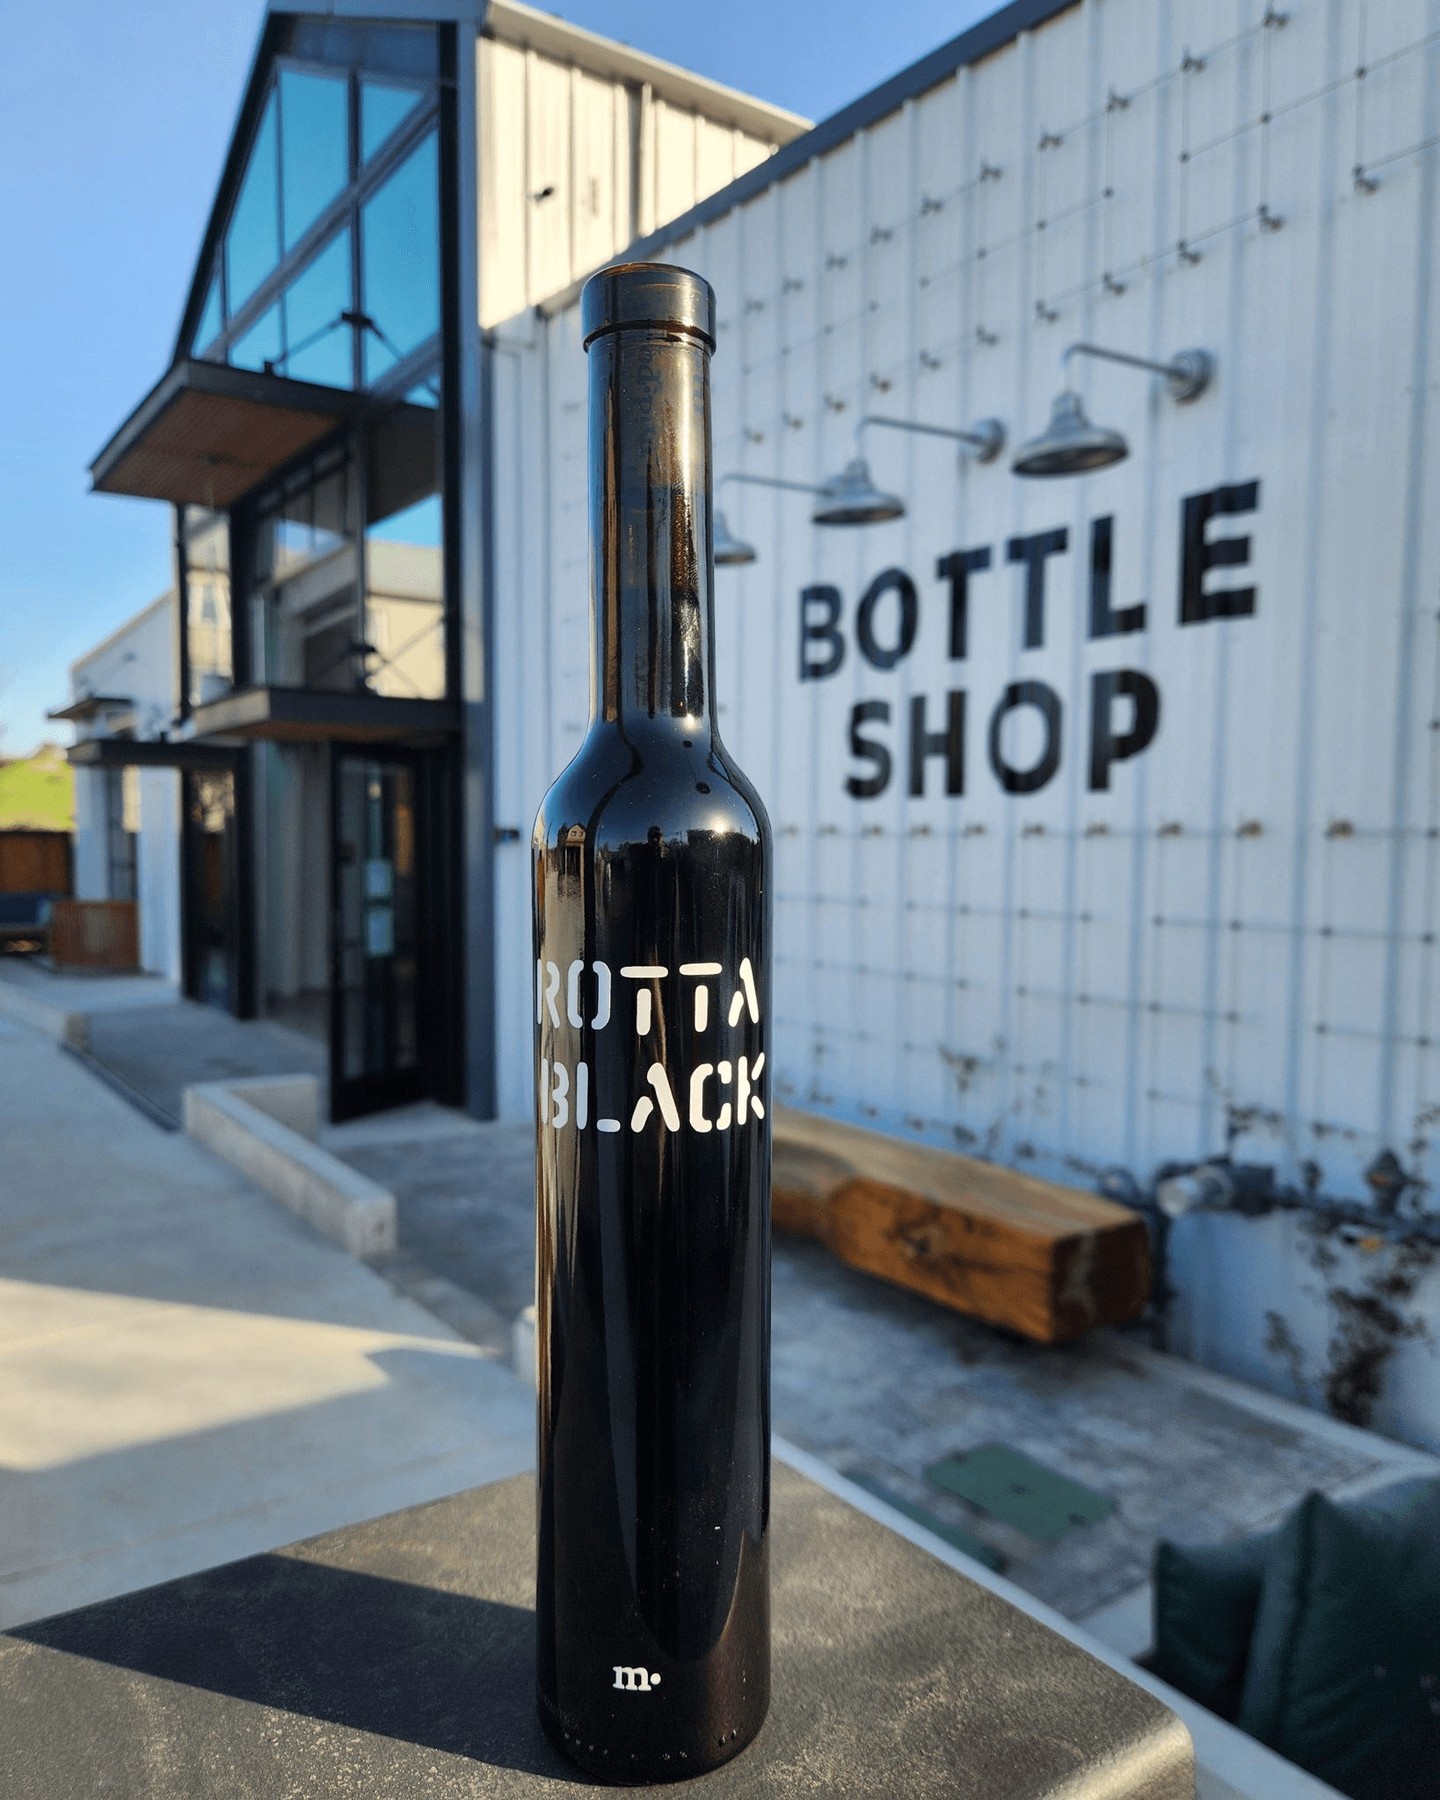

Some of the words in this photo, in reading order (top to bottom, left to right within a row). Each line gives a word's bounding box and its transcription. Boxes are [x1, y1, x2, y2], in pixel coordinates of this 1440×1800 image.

[799, 480, 1259, 682] BOTTLE
[845, 668, 1160, 799] SHOP
[537, 957, 759, 1036] ROTTA
[541, 1051, 765, 1133] BLACK
